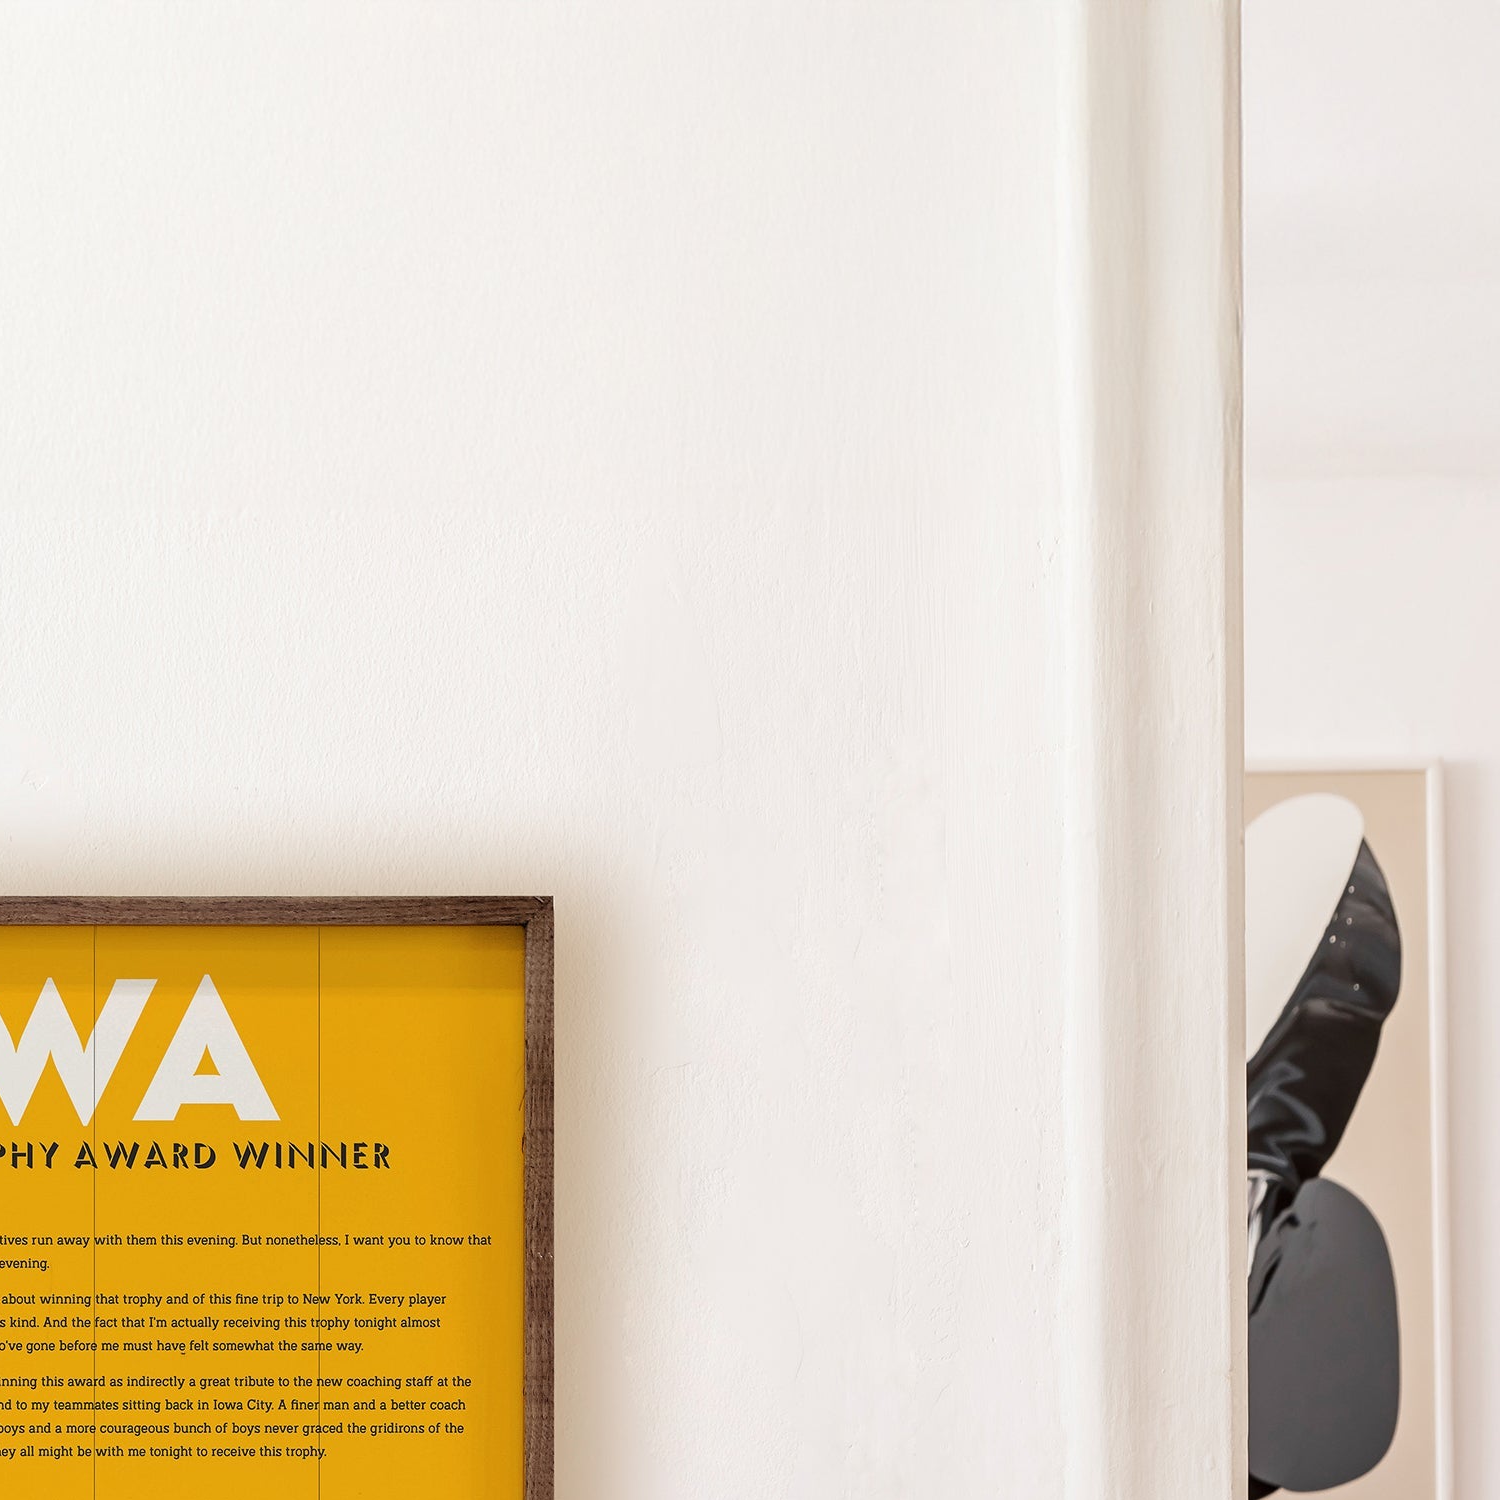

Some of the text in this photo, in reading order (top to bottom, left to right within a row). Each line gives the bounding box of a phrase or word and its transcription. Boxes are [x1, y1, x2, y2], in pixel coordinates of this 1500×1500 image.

[73, 1141, 216, 1170] AWARD
[232, 1141, 390, 1170] WINNER
[31, 1236, 54, 1246] run
[56, 1236, 91, 1249] away
[95, 1233, 123, 1246] with
[126, 1233, 157, 1246] them
[160, 1233, 184, 1246] this
[186, 1234, 239, 1249] evening.
[241, 1233, 263, 1246] But
[265, 1233, 342, 1247] nonetheless,
[344, 1234, 350, 1246] I
[352, 1235, 385, 1246] want
[387, 1236, 411, 1249] you
[414, 1235, 427, 1246] to
[429, 1233, 465, 1246] know
[467, 1233, 492, 1246] that
[25, 1342, 56, 1355] gone
[58, 1339, 98, 1352] before
[100, 1342, 120, 1352] me
[122, 1340, 153, 1352] must
[156, 1339, 186, 1352] have
[189, 1339, 210, 1352] felt
[212, 1339, 275, 1352] somewhat
[277, 1339, 298, 1352] the
[300, 1343, 333, 1352] same
[335, 1342, 364, 1355] way.
